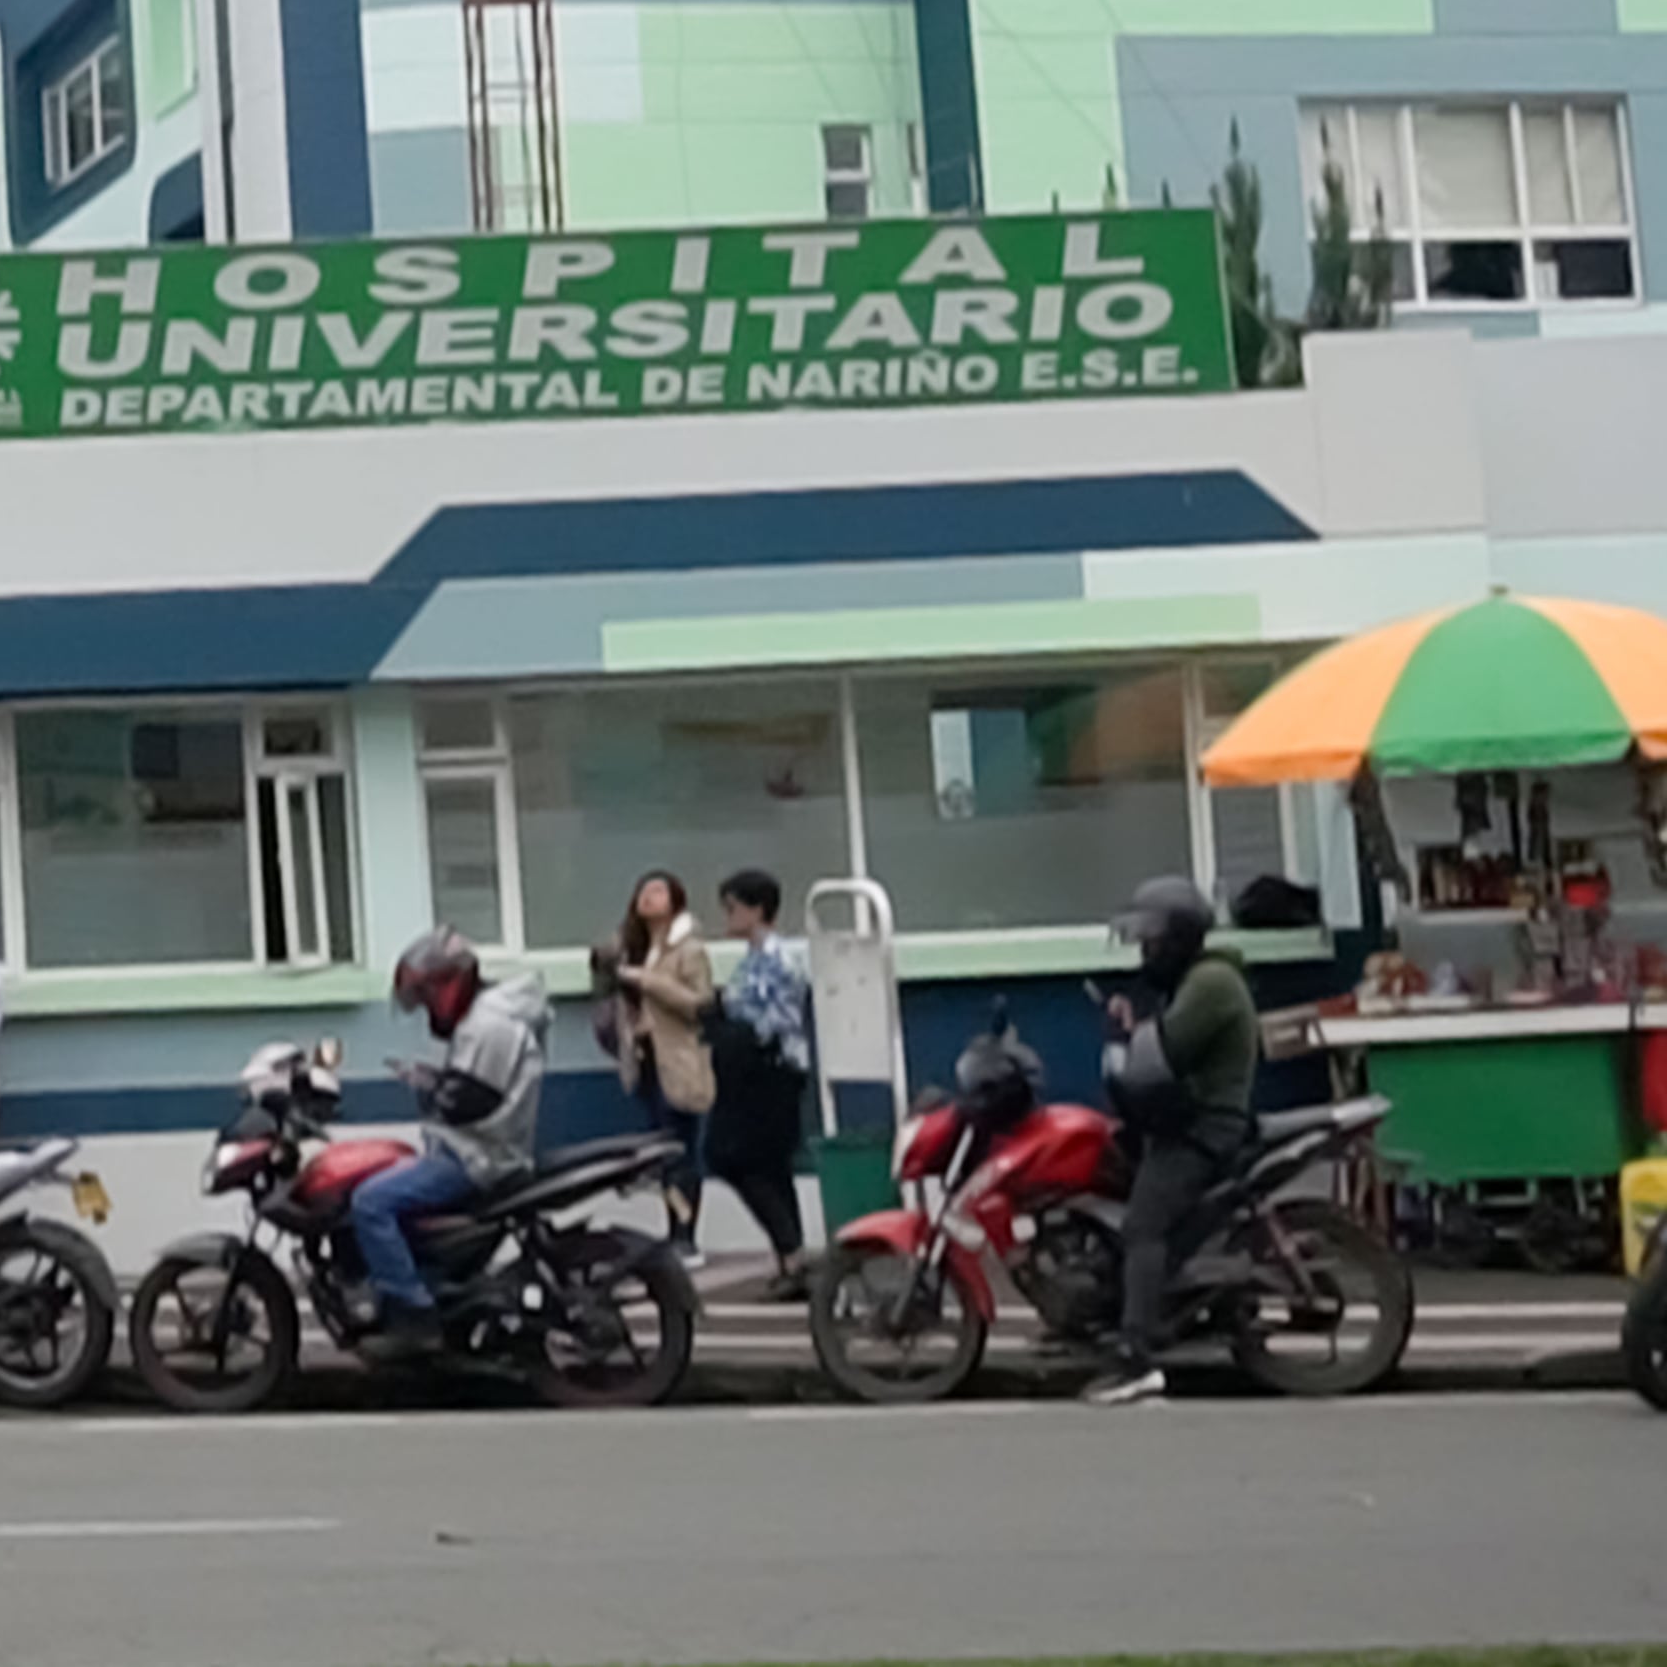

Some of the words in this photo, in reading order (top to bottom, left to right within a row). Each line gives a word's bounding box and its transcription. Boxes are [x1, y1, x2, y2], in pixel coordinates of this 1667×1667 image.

[55, 222, 1145, 317] HOSPITAL
[56, 281, 1174, 379] UNIVERSITARIO
[59, 368, 619, 428] DEPARTAMENTAL
[640, 364, 727, 407] DE
[746, 348, 1000, 401] NARIÑO
[1020, 345, 1200, 390] E.S.E.
